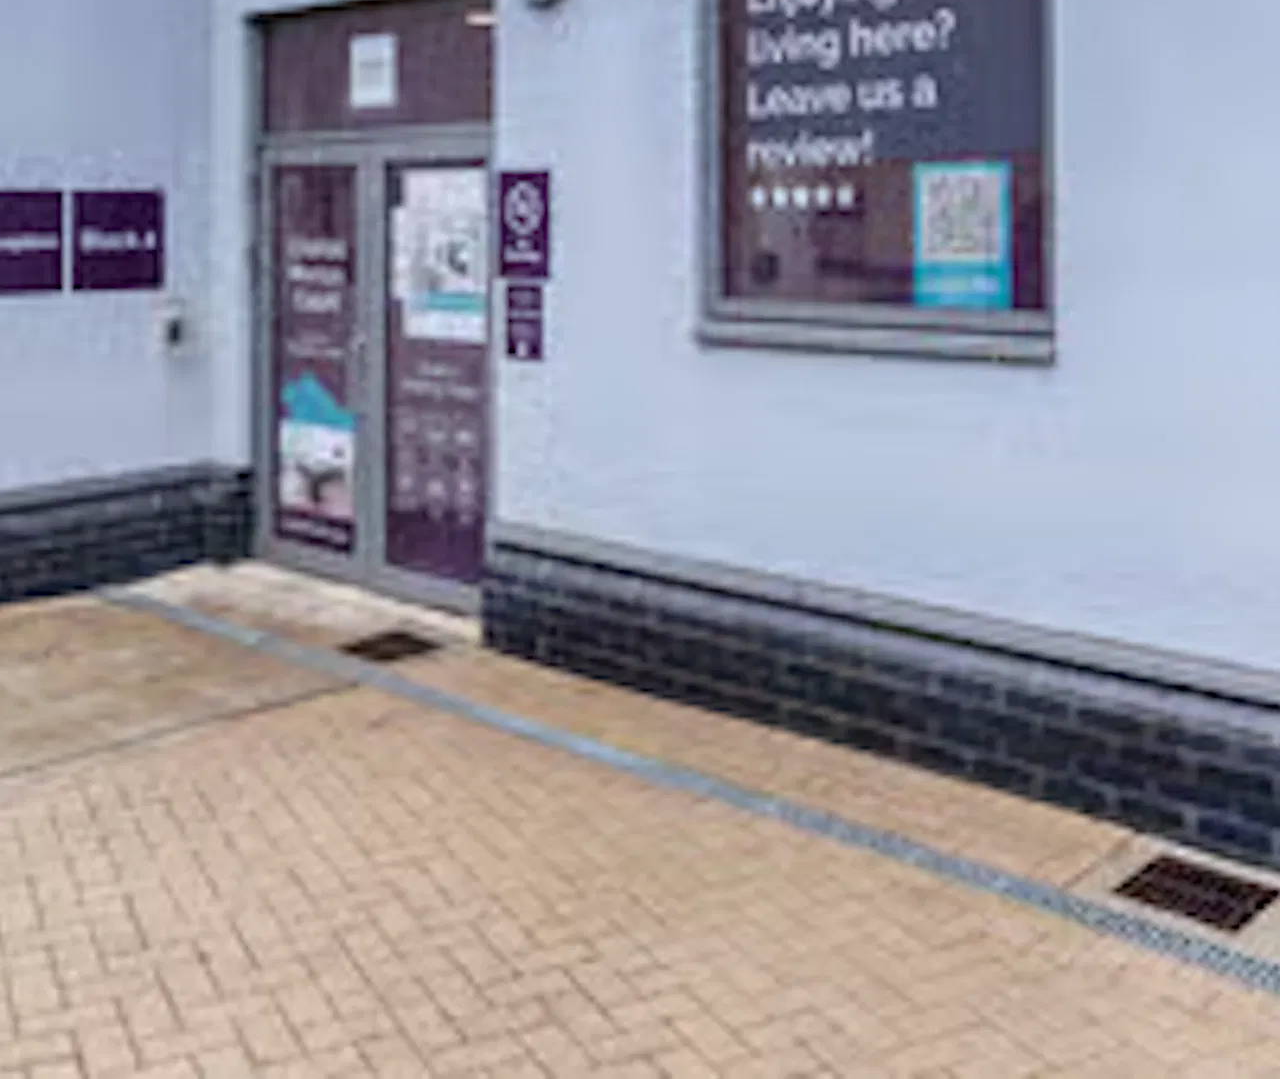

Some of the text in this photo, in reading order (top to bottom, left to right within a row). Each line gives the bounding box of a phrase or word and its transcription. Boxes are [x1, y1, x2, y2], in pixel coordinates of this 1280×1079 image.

[747, 8, 957, 68] living here?
[746, 73, 938, 119] Leave us a
[746, 129, 874, 171] review!
